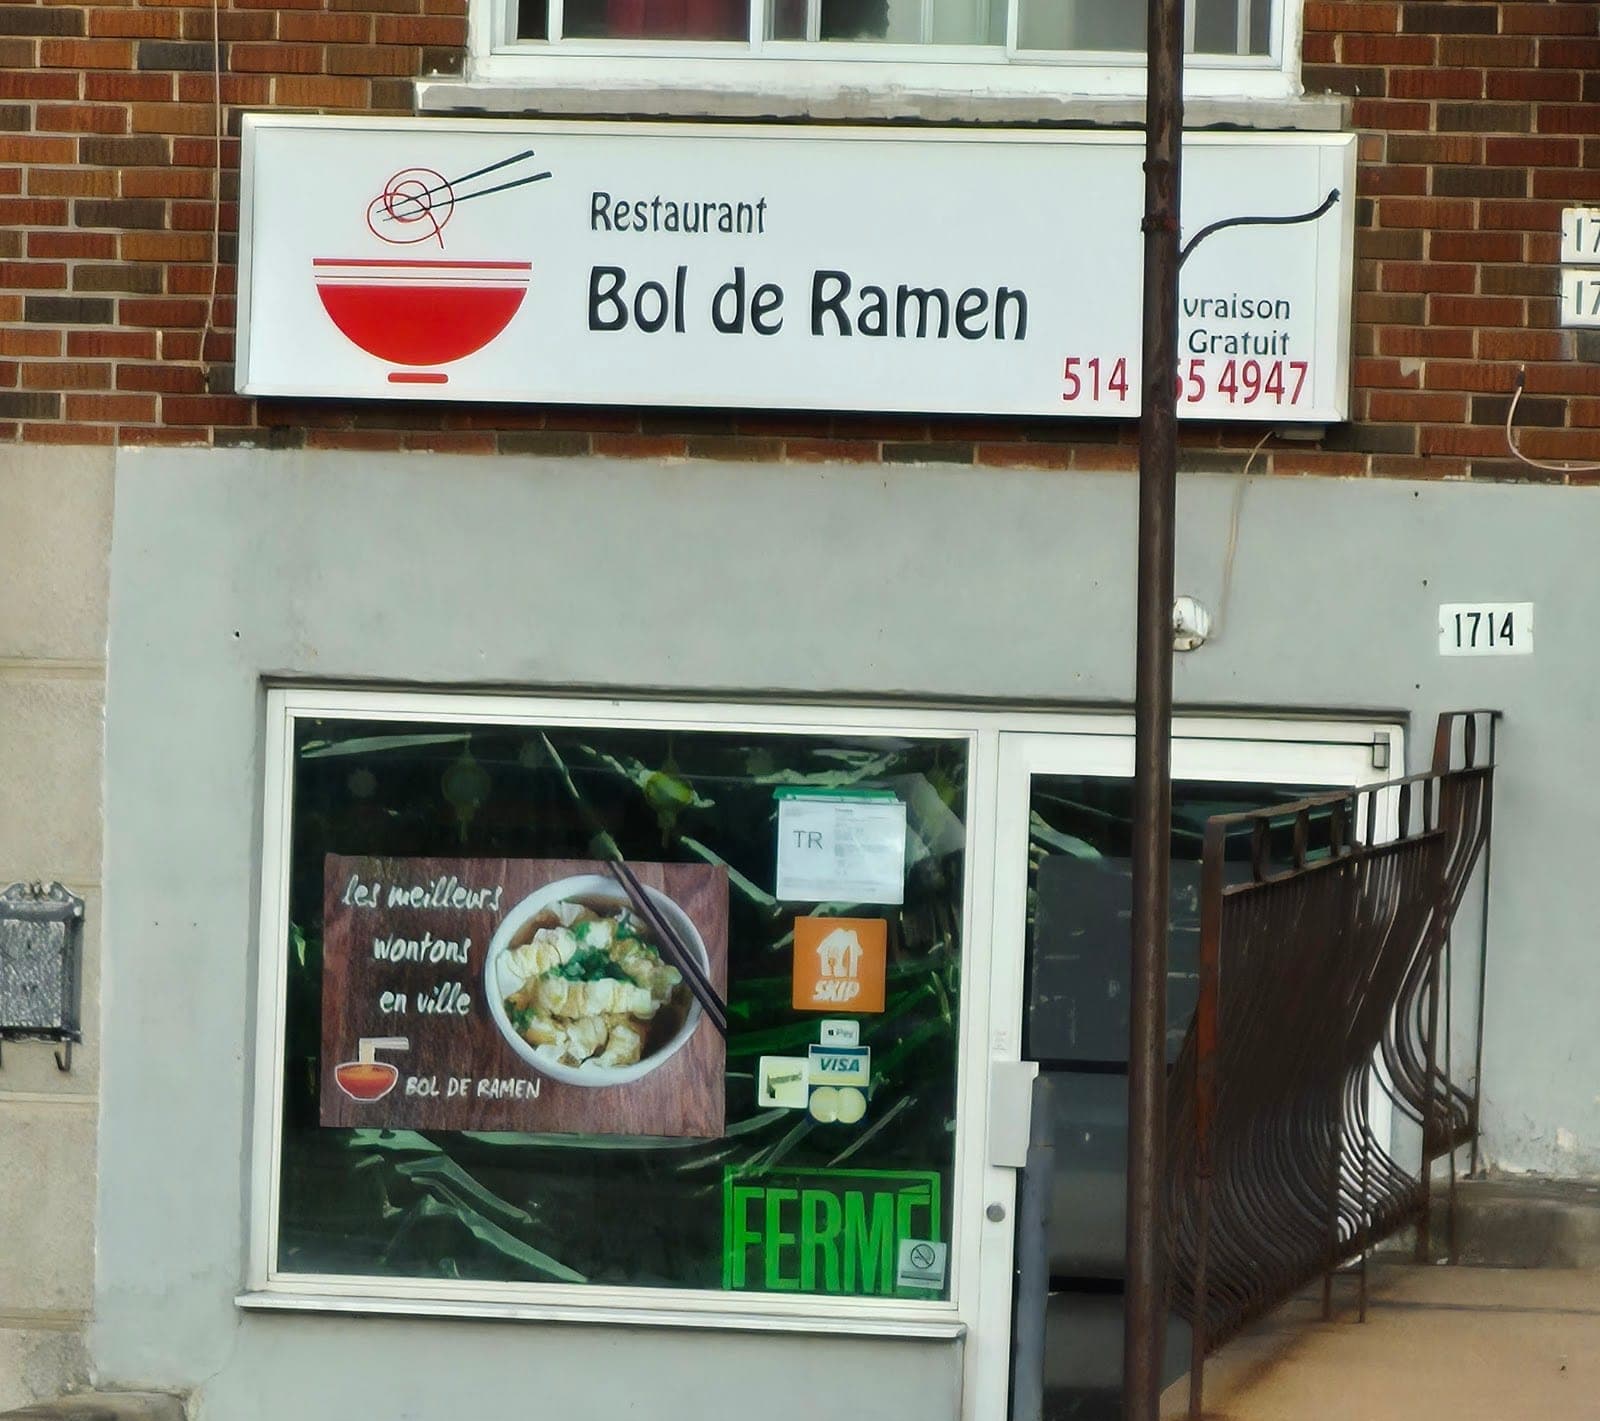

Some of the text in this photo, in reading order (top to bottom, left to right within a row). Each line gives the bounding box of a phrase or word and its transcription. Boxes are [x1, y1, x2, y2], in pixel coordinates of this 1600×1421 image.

[590, 191, 768, 233] Restaurant
[588, 265, 1028, 341] Bol de Ramen
[1183, 292, 1291, 320] vraison
[1188, 328, 1290, 355] Gratuit
[1063, 356, 1130, 402] 514
[1217, 359, 1309, 405] 4947
[1455, 611, 1515, 647] 1714
[387, 875, 503, 912] meilleurs
[379, 982, 471, 1015] en ville
[811, 979, 861, 1003] SKIP
[820, 1057, 861, 1073] VISA
[405, 1076, 541, 1099] BOL DE RAMEN
